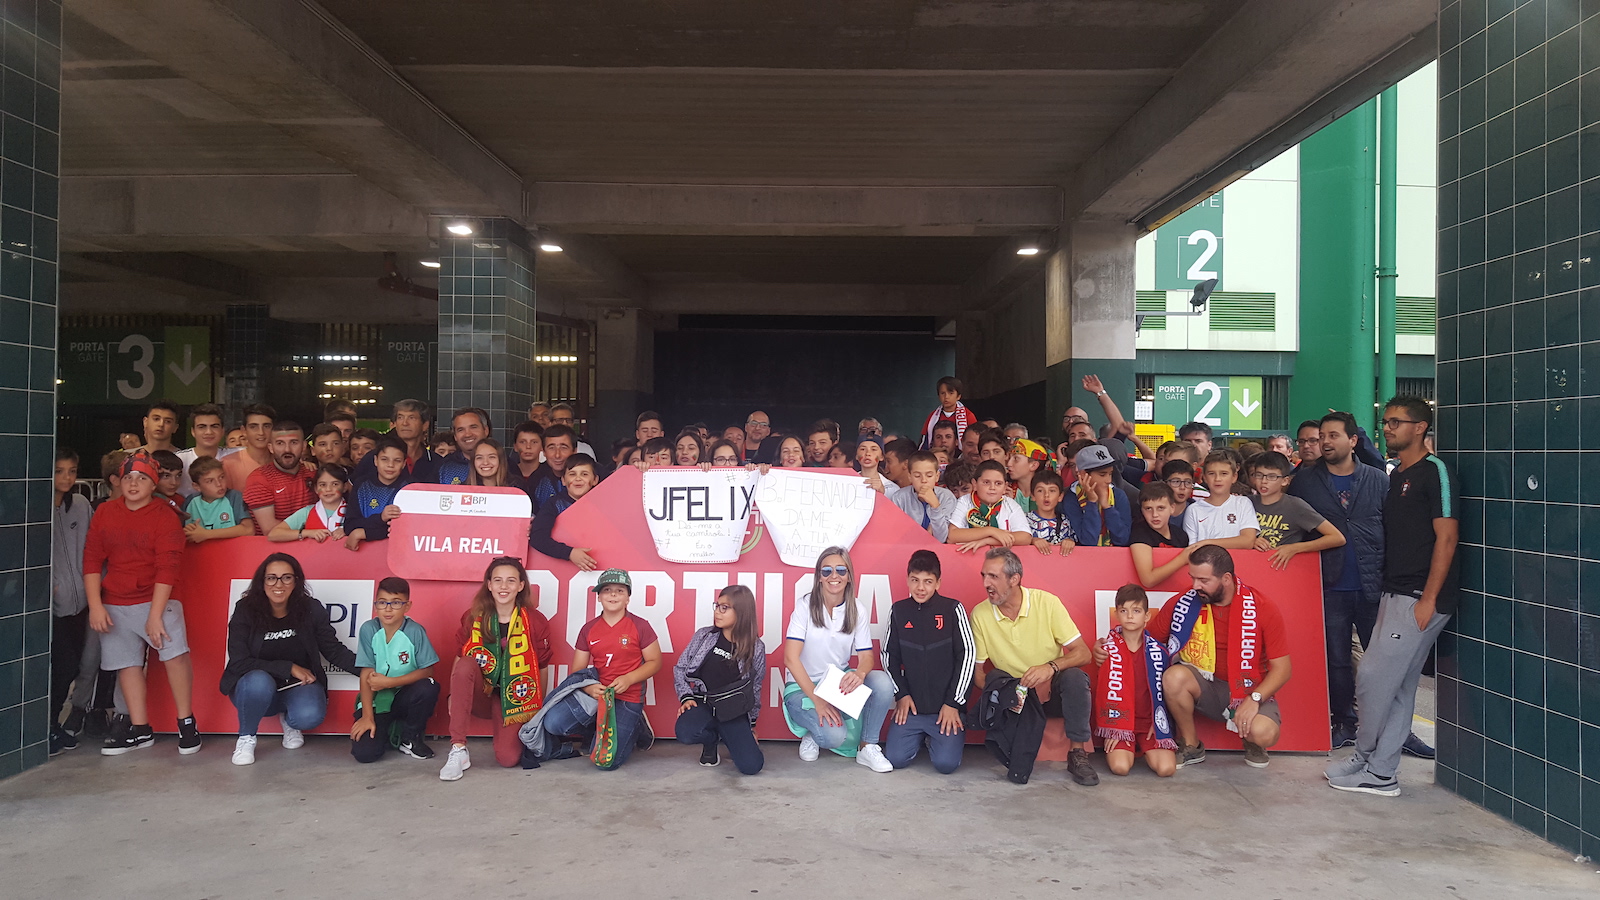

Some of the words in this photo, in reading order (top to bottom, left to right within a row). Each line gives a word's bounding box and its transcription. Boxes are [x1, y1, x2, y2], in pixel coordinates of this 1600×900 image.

[1187, 230, 1218, 280] 2
[70, 342, 105, 351] PORTA
[388, 341, 425, 351] PORTA
[78, 353, 104, 362] GATE
[397, 352, 425, 362] GATE
[117, 334, 155, 399] 3
[1193, 381, 1221, 426] 2
[472, 496, 487, 504] BPI
[791, 529, 802, 541] A
[413, 535, 453, 553] VILA
[458, 537, 504, 555] REAL
[325, 603, 359, 638] PI
[1241, 592, 1257, 670] PORTUGAL
[605, 653, 613, 667] 7
[506, 703, 539, 715] PORTUGAL
